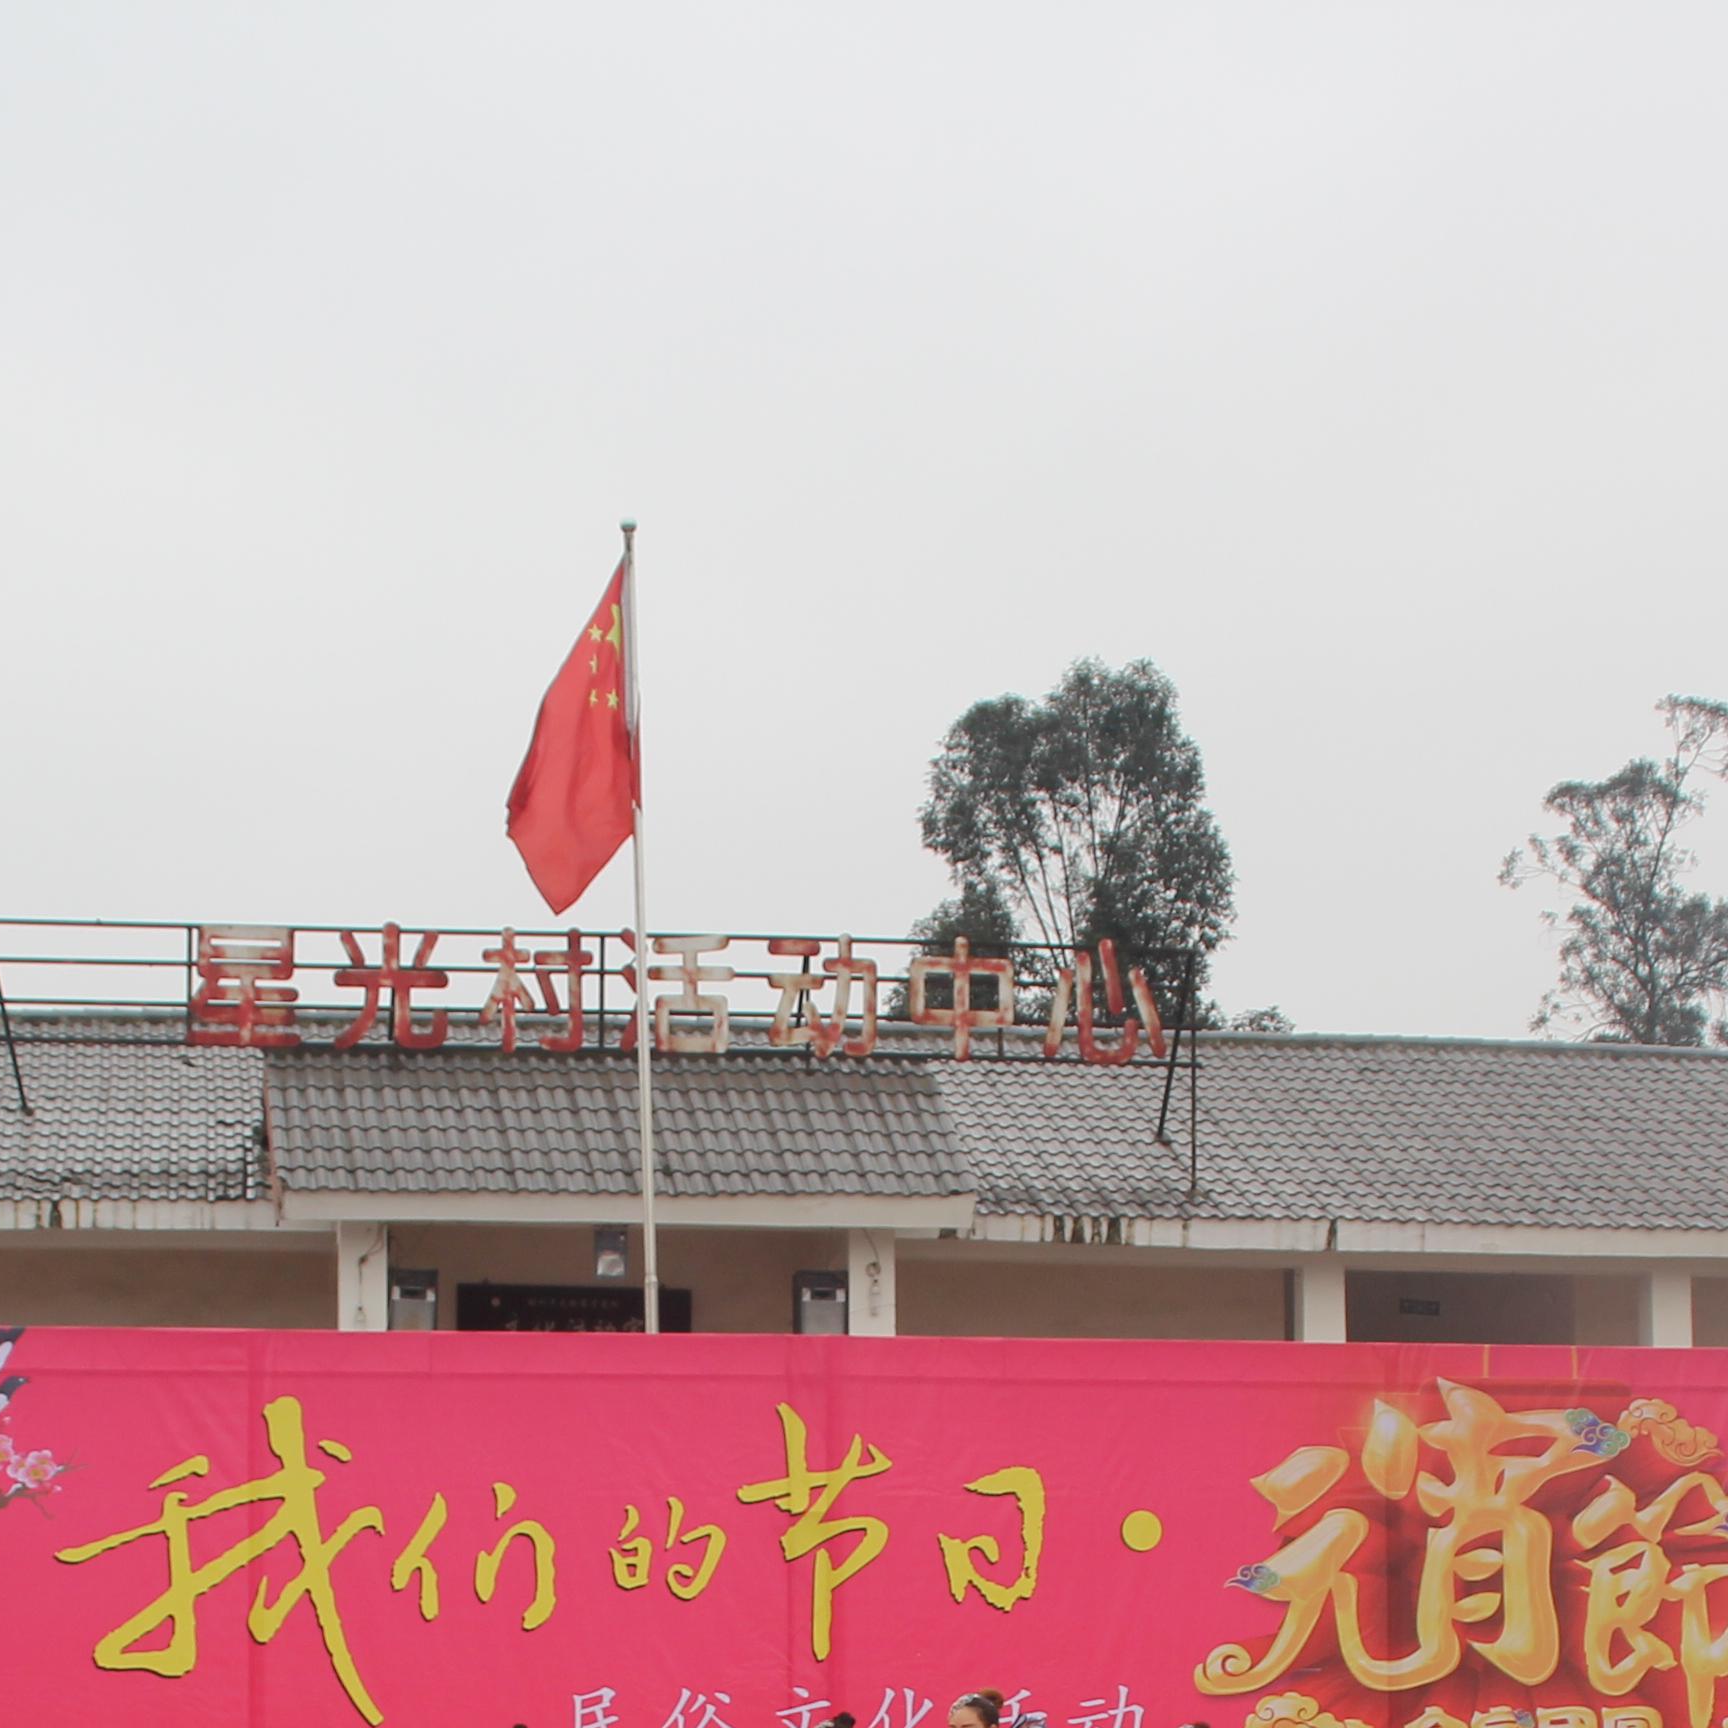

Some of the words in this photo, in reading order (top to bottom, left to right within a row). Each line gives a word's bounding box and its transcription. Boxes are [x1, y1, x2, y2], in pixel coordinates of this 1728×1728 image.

[186, 922, 1167, 1064] 星光村活动中心
